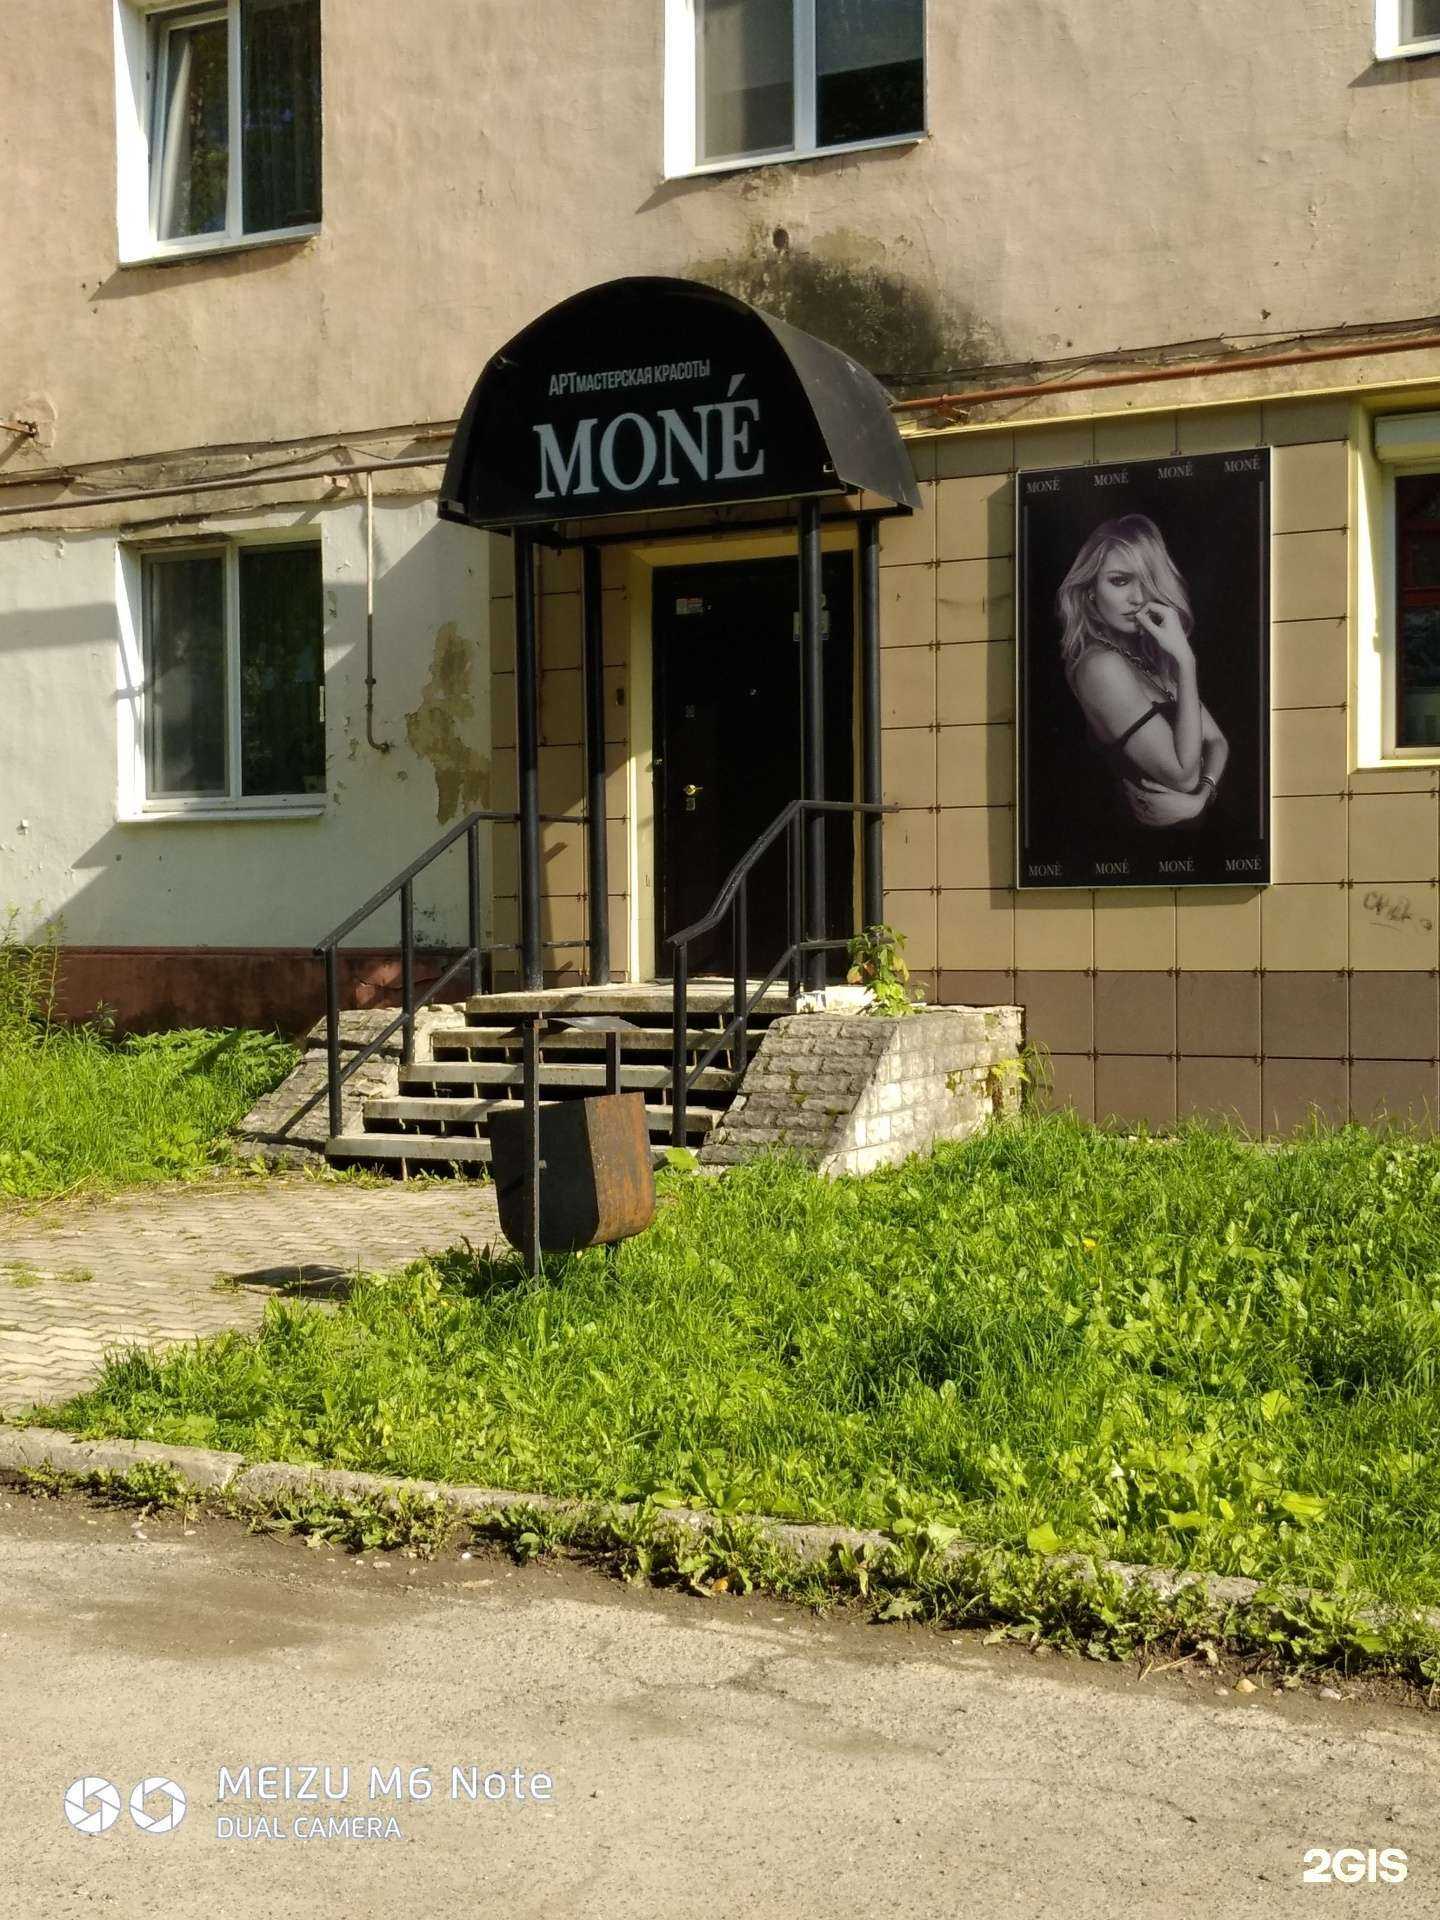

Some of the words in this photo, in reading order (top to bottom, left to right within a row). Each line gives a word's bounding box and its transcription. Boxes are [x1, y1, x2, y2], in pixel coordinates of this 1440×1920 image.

[653, 359, 711, 384] КРАСОТЫ
[532, 373, 765, 500] MONÉ
[1025, 476, 1061, 494] MONÉ
[1093, 469, 1129, 487] MONÉ
[1157, 461, 1193, 480] MONÉ
[1223, 455, 1261, 473] MONÉ
[1028, 863, 1063, 877] MONÉ
[1095, 858, 1130, 875] MONÉ
[1159, 857, 1195, 873] MONÉ
[1225, 855, 1262, 872] MONÉ
